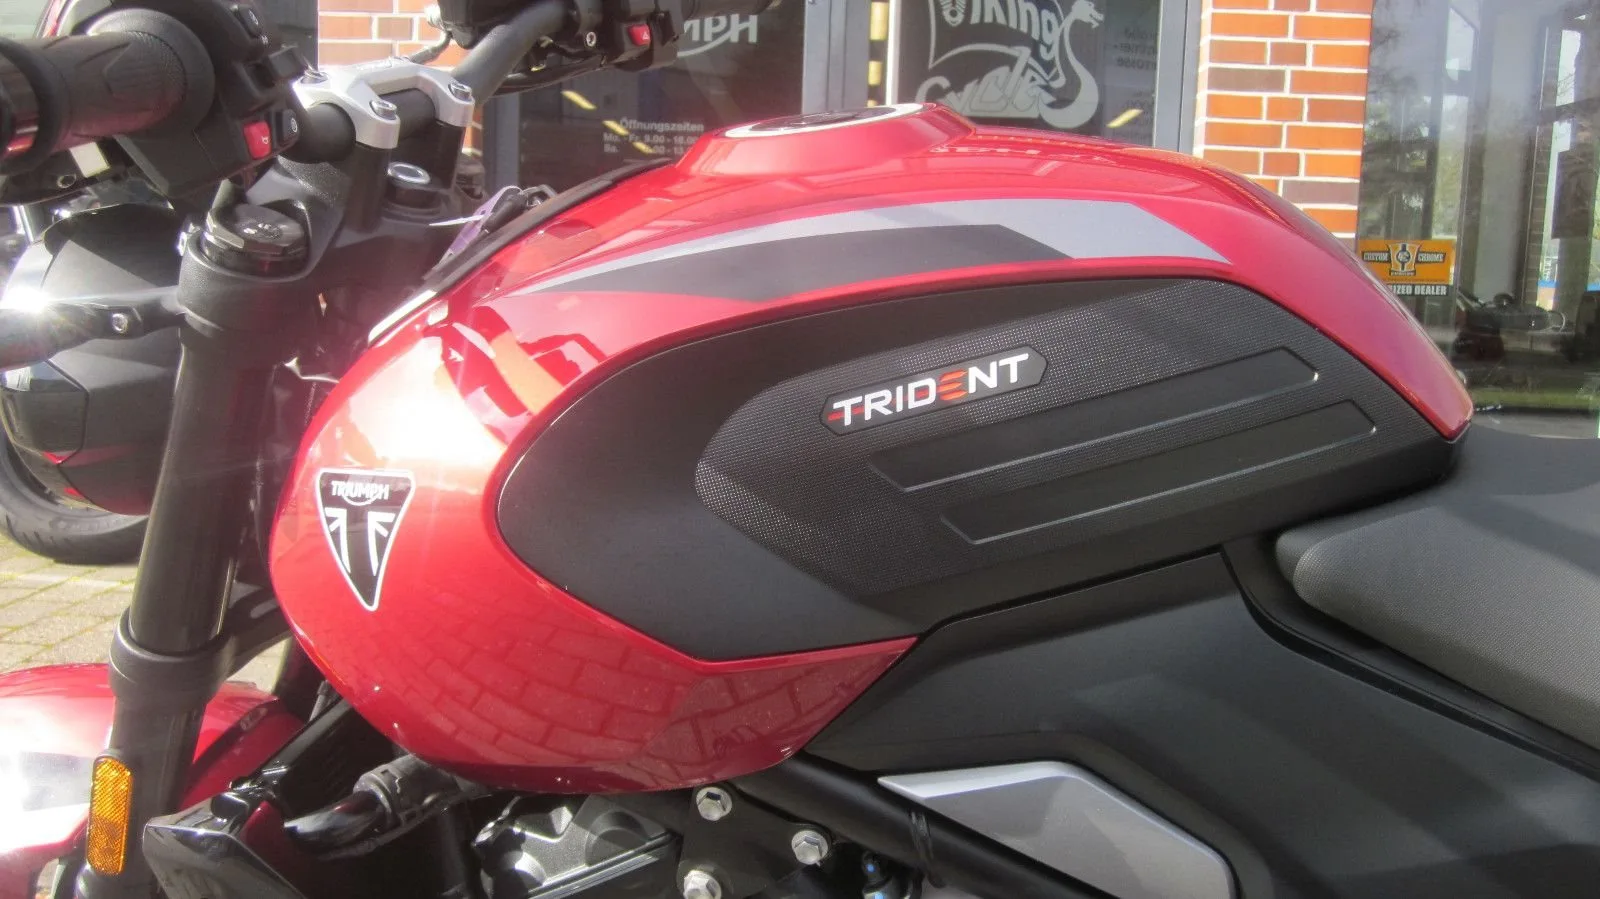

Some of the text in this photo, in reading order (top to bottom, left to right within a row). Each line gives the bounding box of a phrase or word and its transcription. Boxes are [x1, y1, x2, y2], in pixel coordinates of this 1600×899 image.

[620, 116, 705, 132] Öffnungszeiten
[1414, 285, 1447, 296] DEALER
[829, 353, 1029, 426] TRIDENT
[331, 480, 390, 504] TRIUMPH
